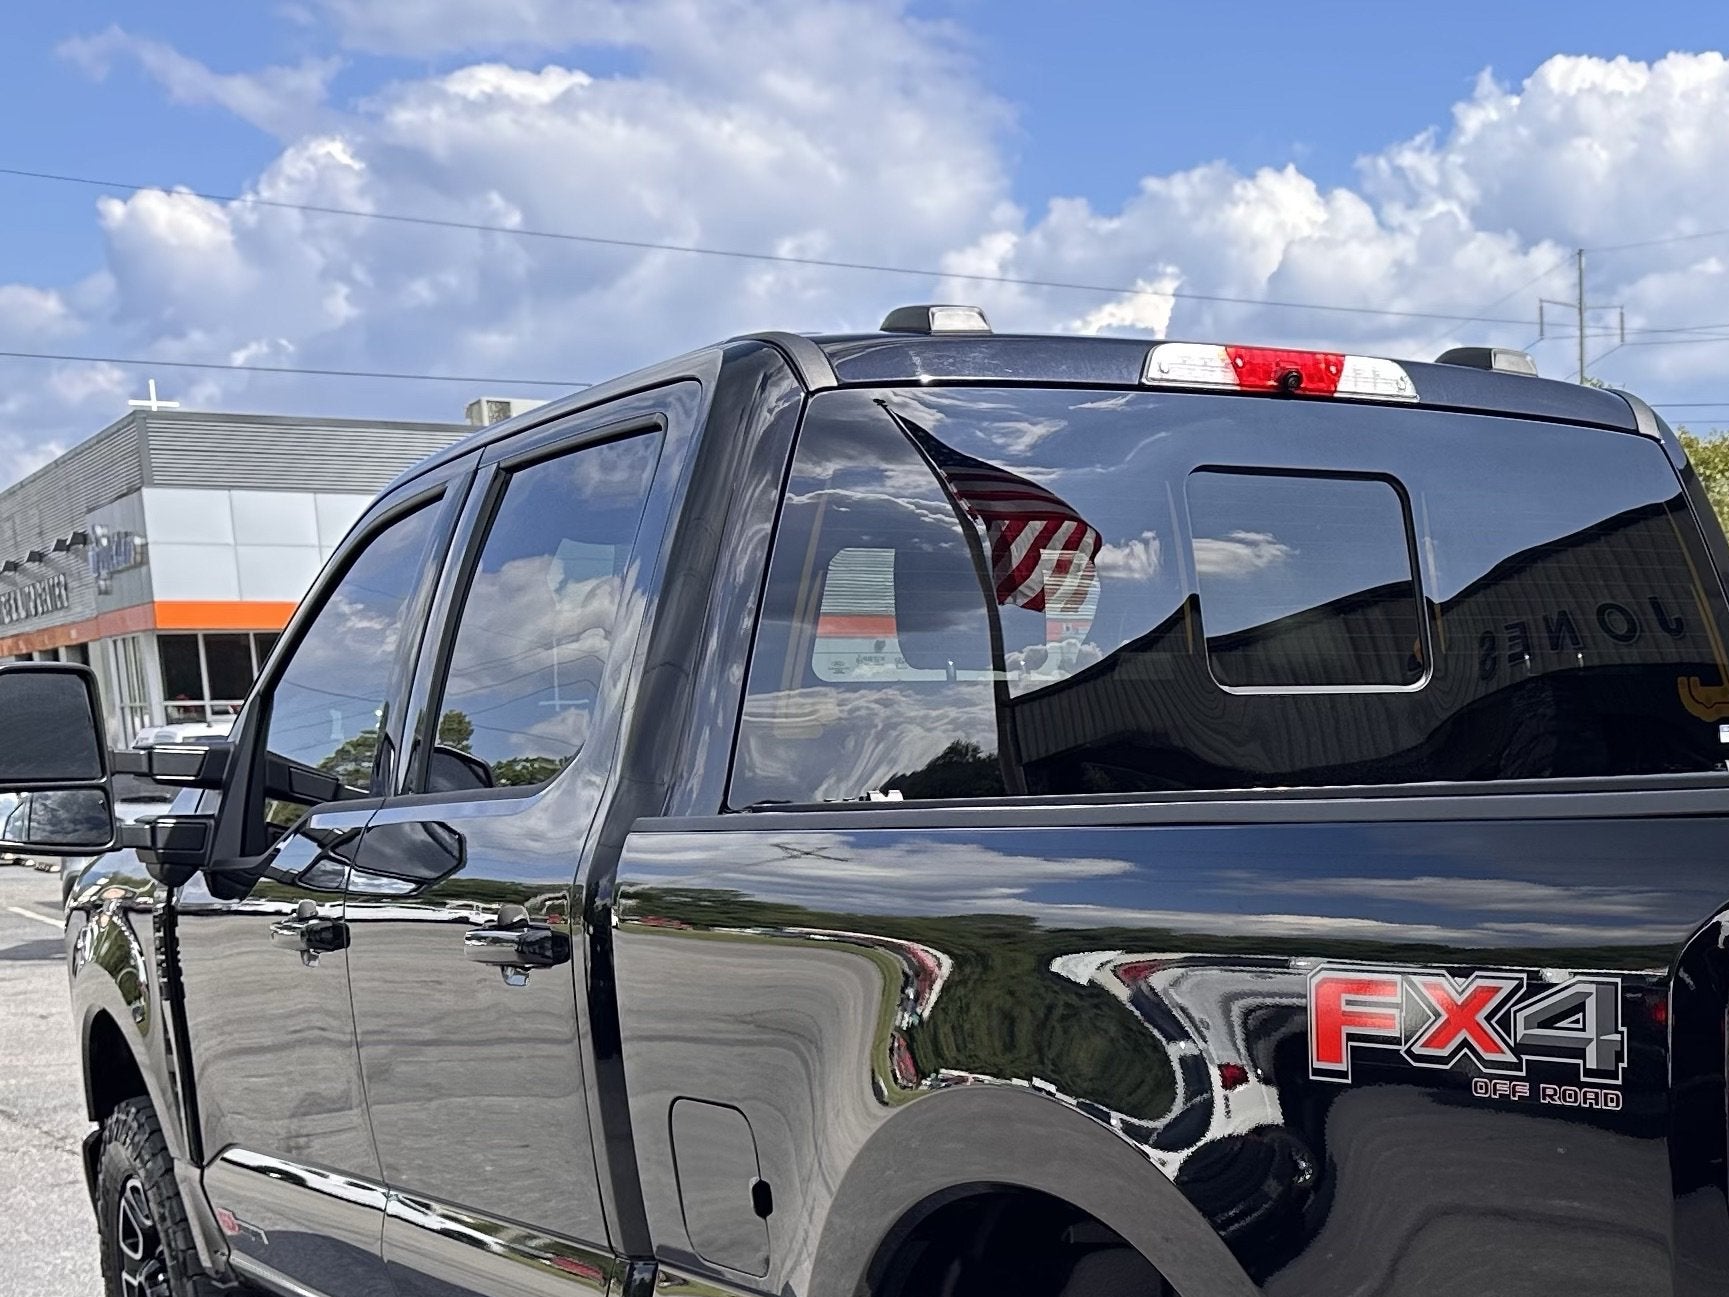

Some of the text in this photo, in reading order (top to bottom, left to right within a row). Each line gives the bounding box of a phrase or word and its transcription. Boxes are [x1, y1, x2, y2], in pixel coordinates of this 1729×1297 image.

[1307, 964, 1627, 1084] FX4
[1472, 1077, 1623, 1112] OFF ROAD
